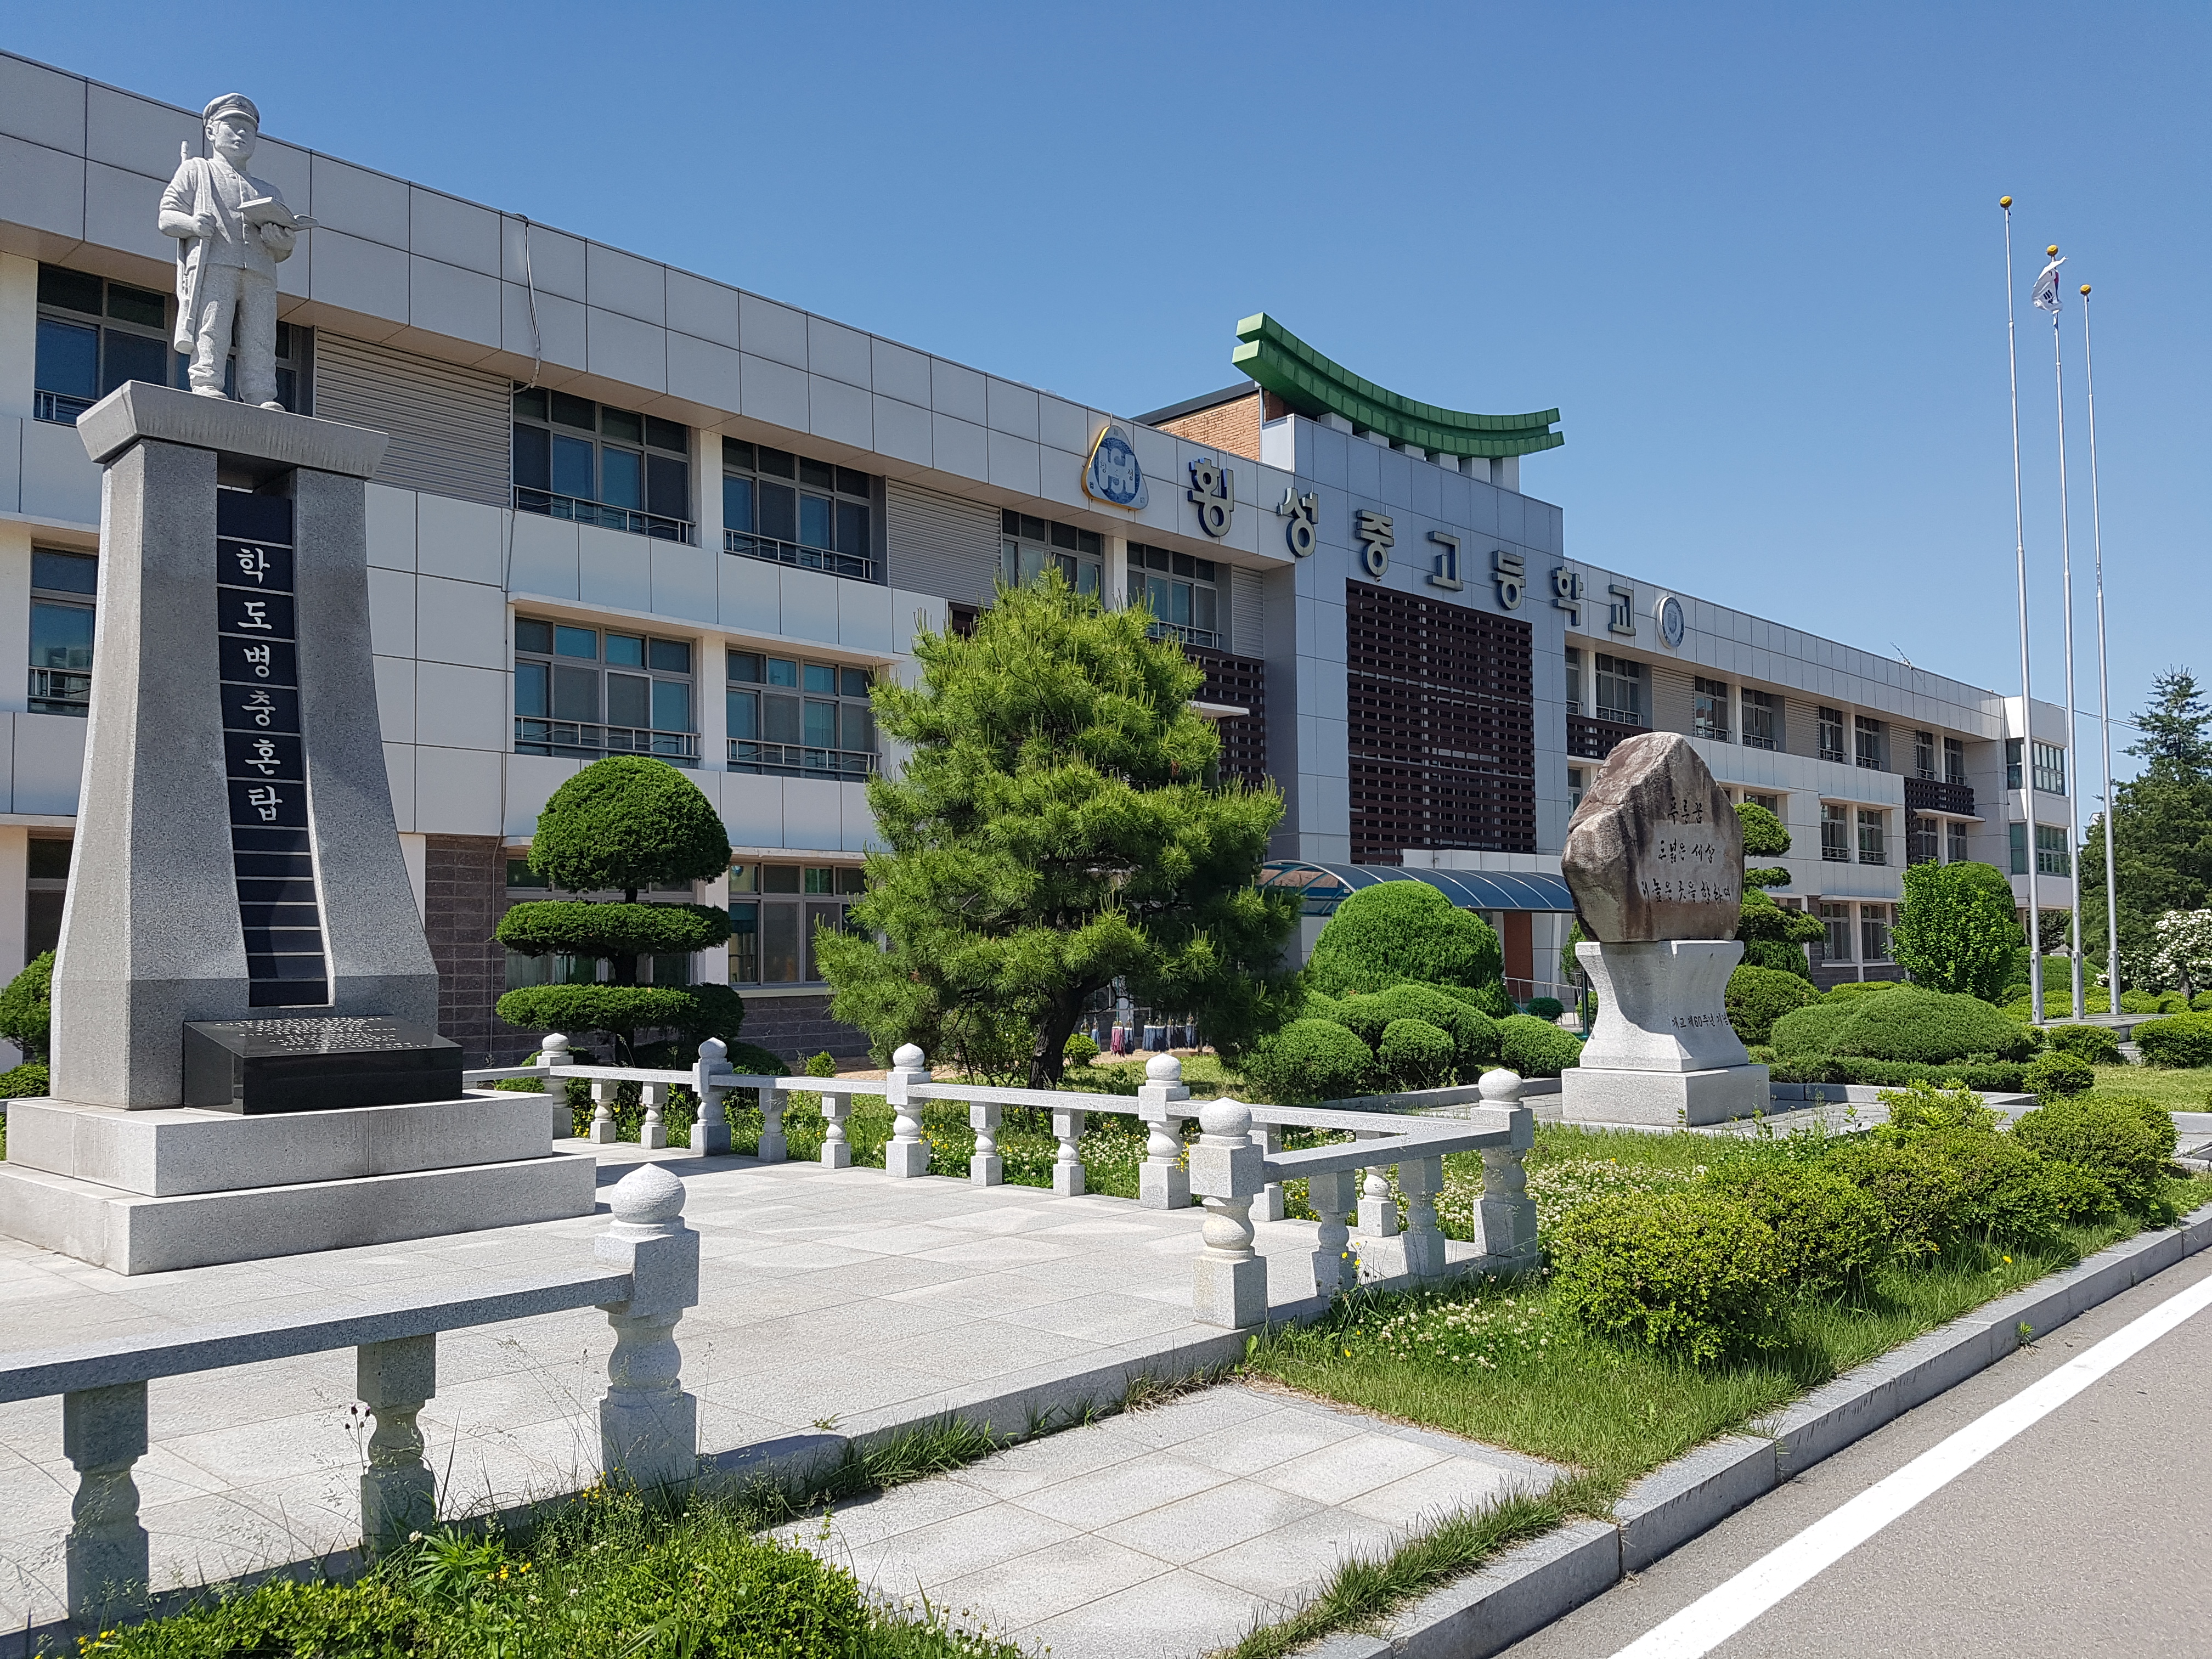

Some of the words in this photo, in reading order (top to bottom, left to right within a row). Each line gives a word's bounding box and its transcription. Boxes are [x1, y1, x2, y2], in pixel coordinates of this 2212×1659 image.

[1691, 843, 1716, 864] 세상
[1678, 880, 1696, 903] 곳을
[1701, 880, 1731, 905] 향하여
